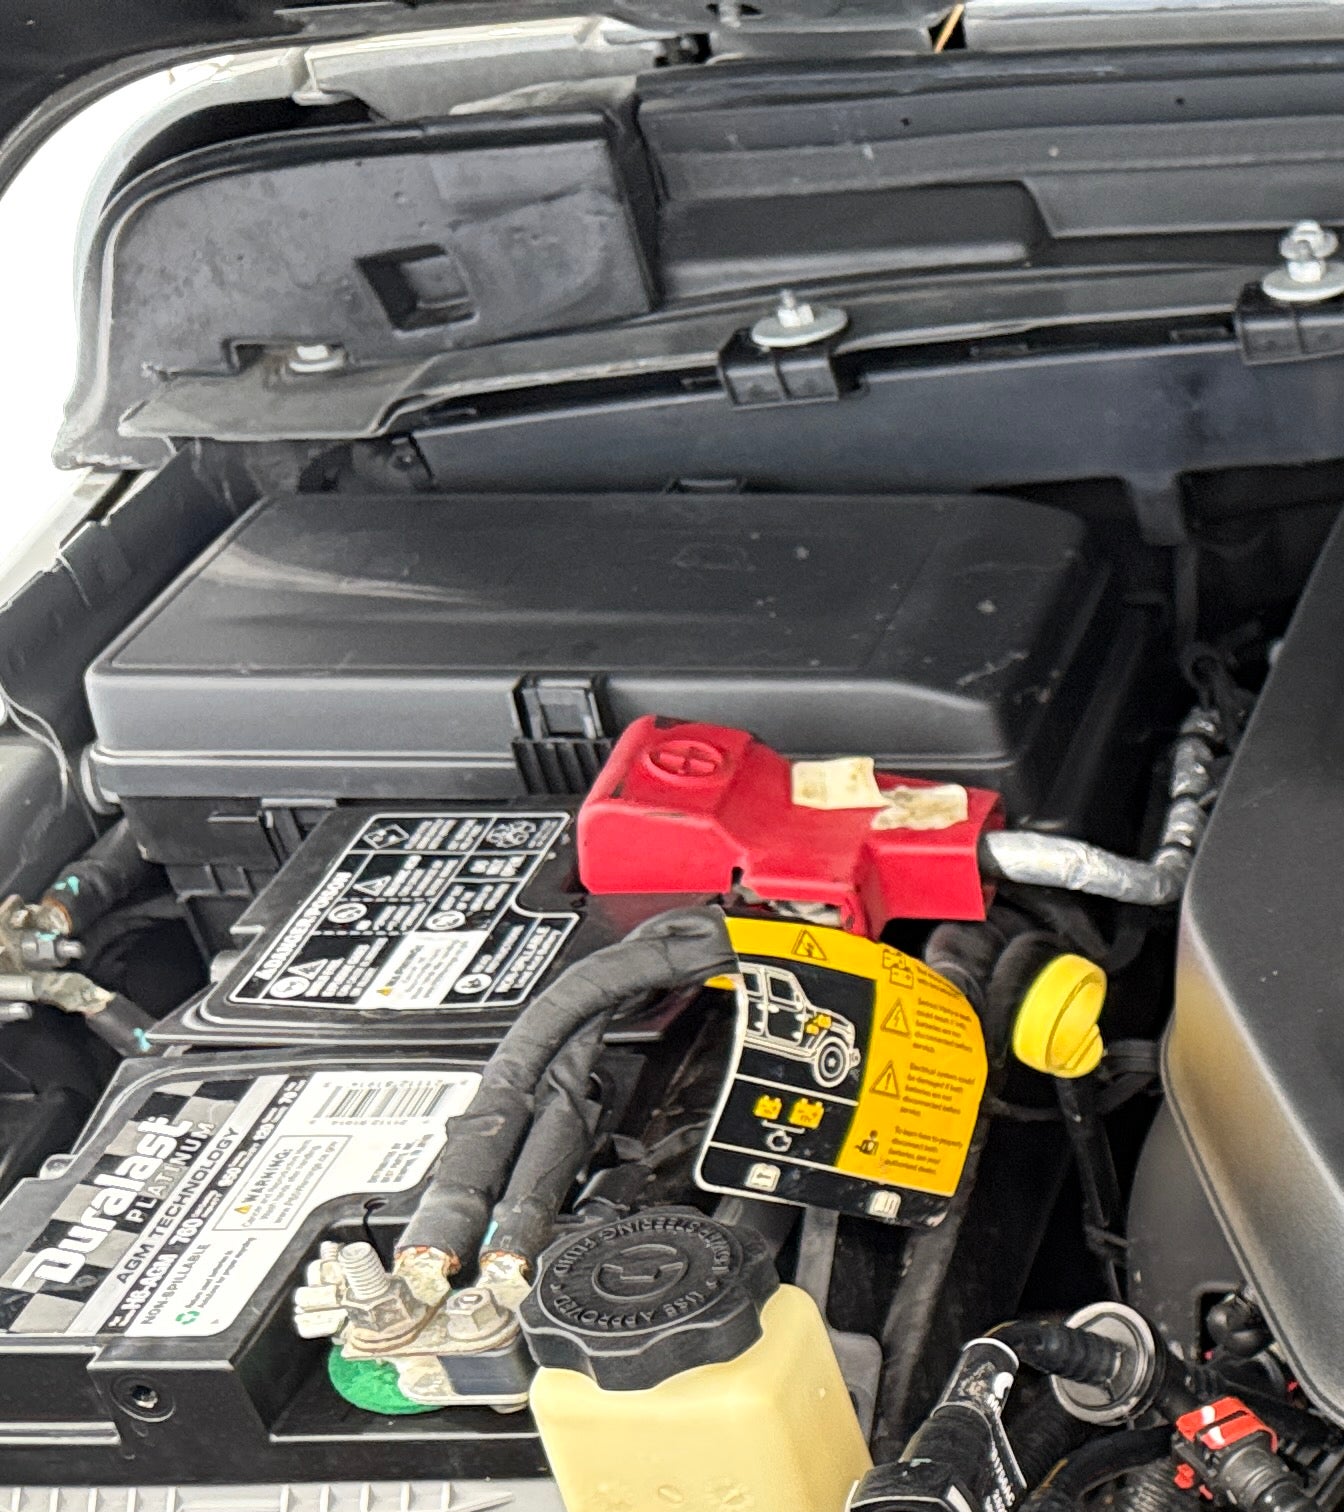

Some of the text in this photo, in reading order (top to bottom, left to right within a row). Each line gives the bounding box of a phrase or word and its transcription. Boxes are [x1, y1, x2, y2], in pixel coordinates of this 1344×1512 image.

[12, 1116, 193, 1289] Duralast
[116, 1244, 156, 1284] AGM
[148, 1127, 240, 1239] TECHNOLOGY
[125, 1122, 215, 1223] PLATINUM
[553, 1236, 598, 1278] FLUID
[600, 1215, 701, 1241] STEERING
[553, 1290, 706, 1330] USE APPROVED
